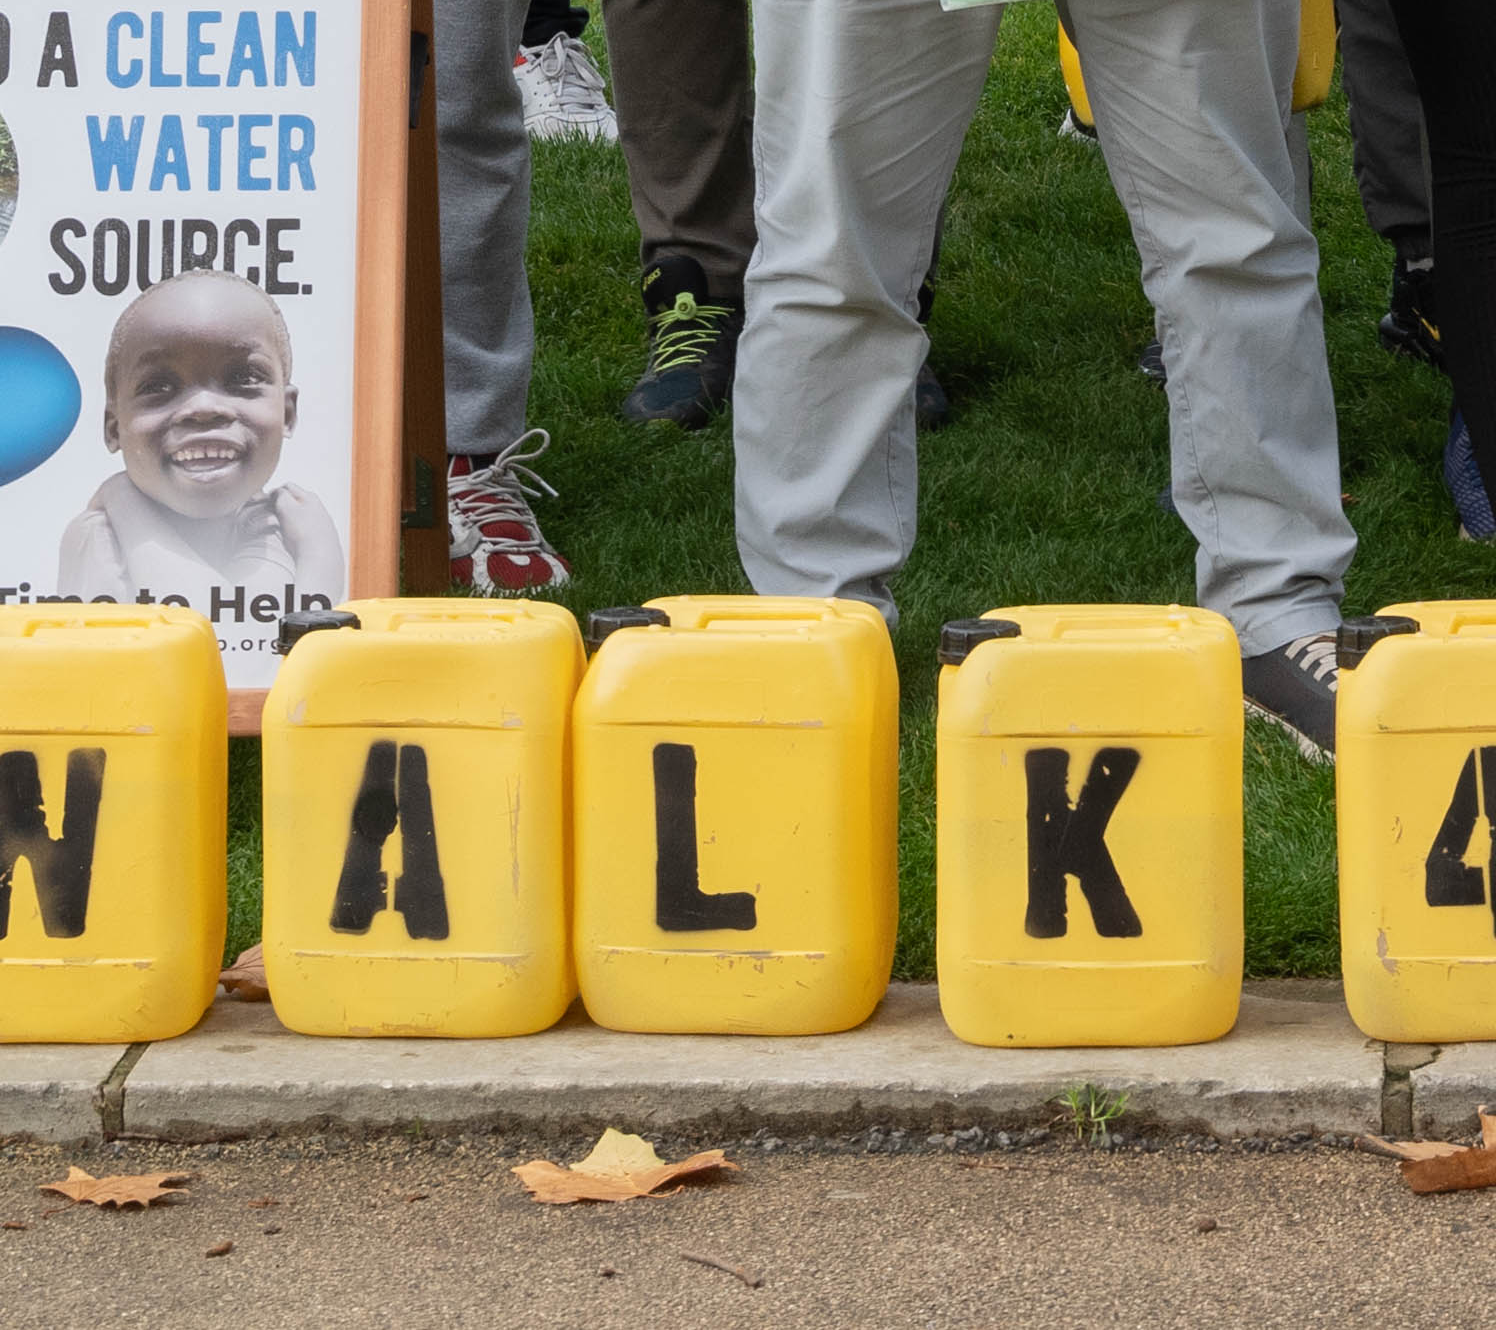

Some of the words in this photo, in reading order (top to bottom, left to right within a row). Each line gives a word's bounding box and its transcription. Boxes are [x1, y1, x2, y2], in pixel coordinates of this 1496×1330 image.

[36, 10, 79, 90] A
[105, 10, 318, 90] CLEAN
[85, 113, 318, 194] WATER
[47, 216, 313, 297] SOURCE.
